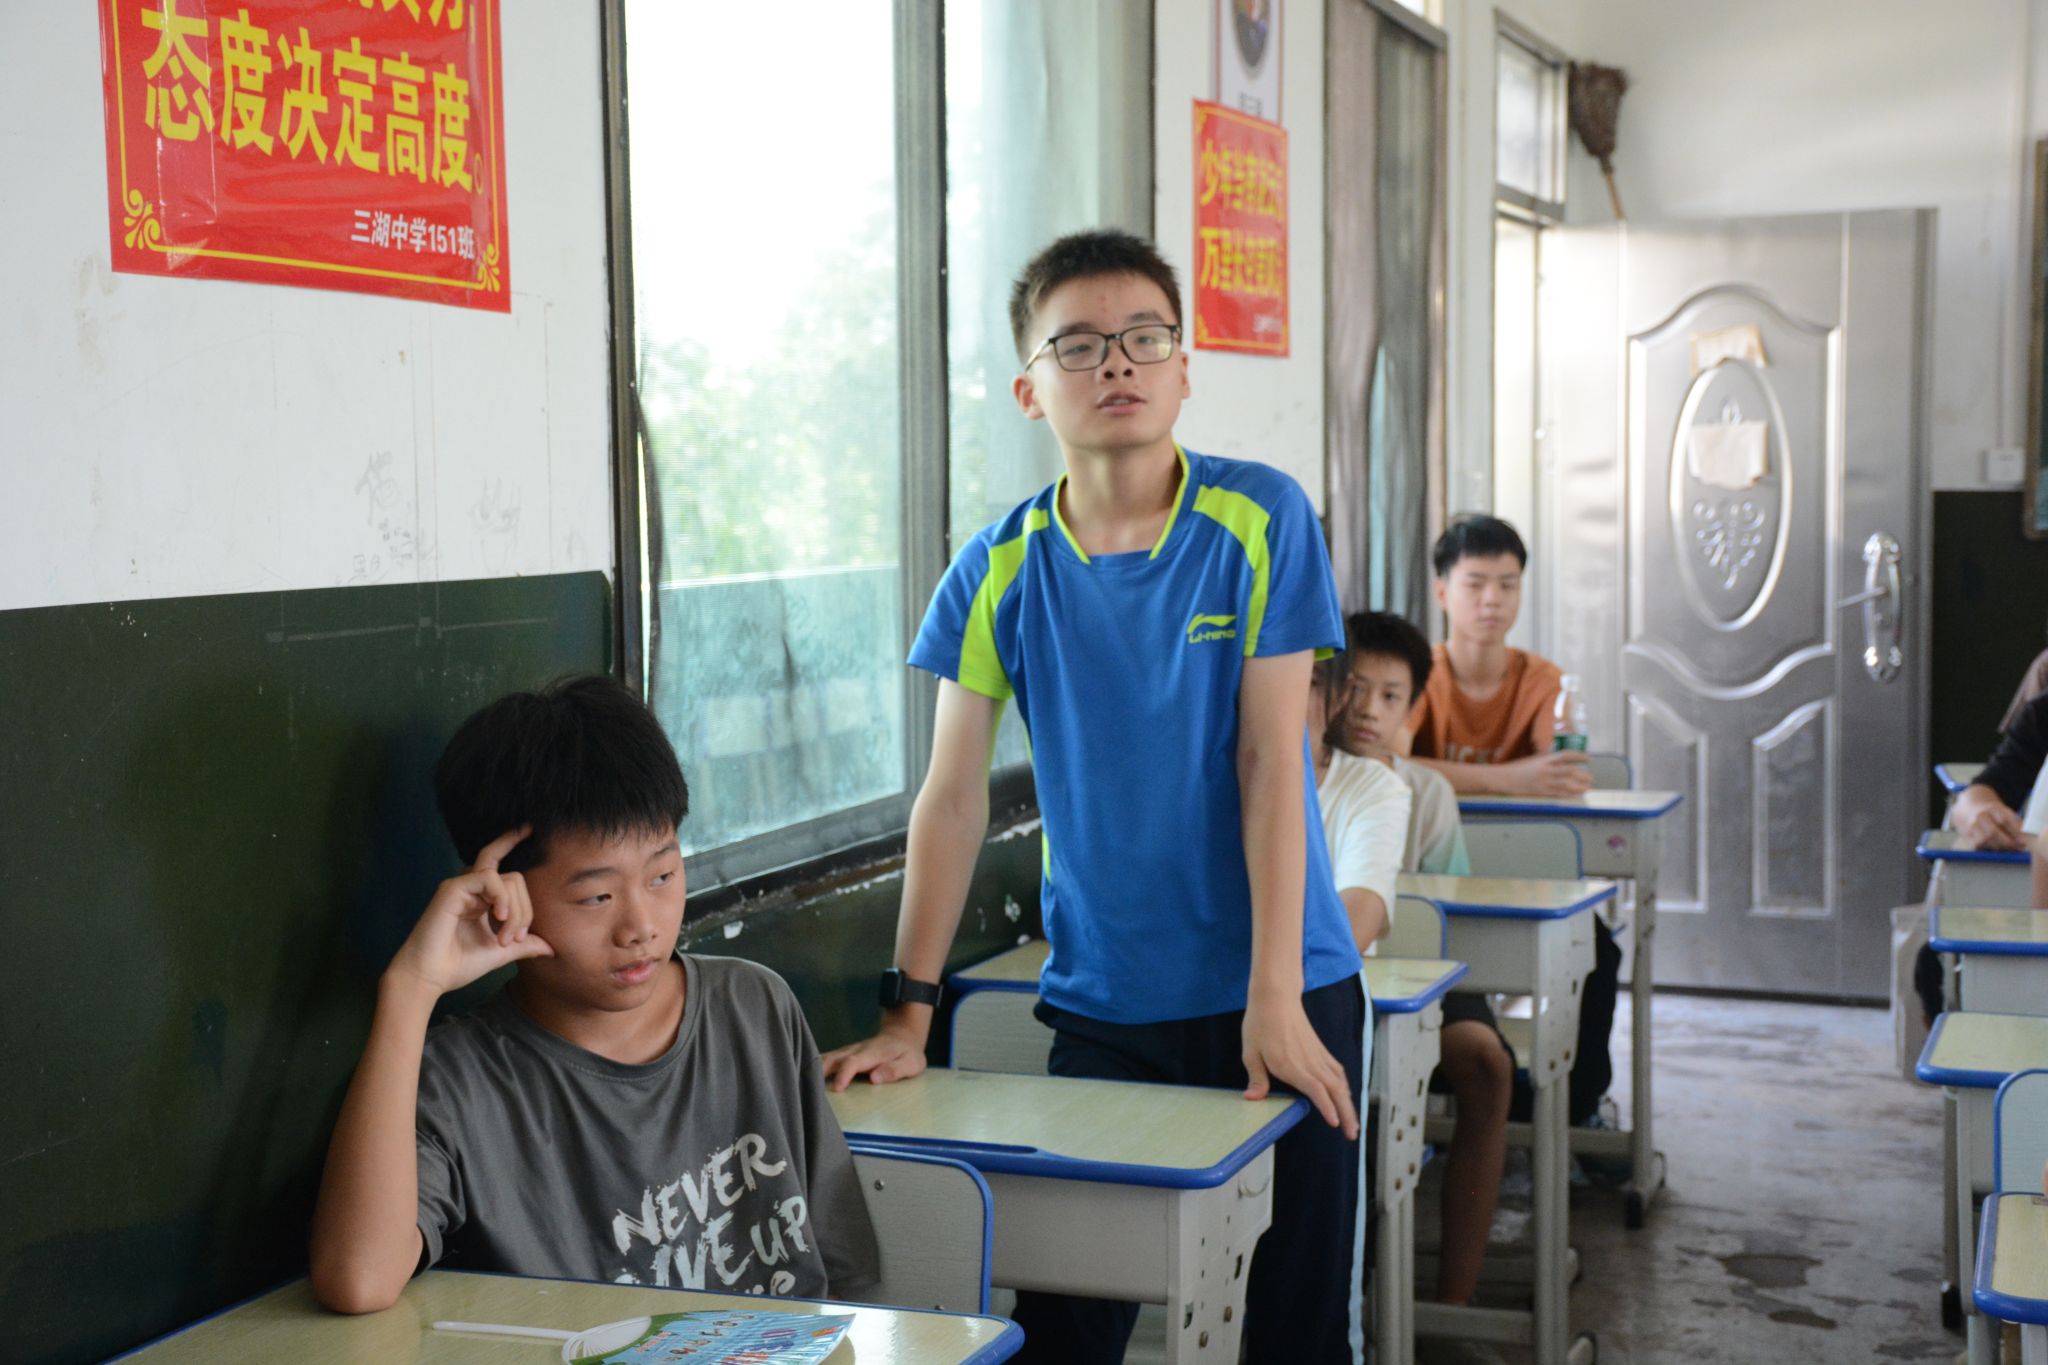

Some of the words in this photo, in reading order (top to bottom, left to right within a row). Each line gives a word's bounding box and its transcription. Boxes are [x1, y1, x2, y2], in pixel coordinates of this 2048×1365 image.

[351, 209, 475, 259] 三湖中学151班
[612, 1133, 788, 1255] NEVER
[613, 1210, 756, 1291] IVE
[751, 1196, 811, 1263] UP
